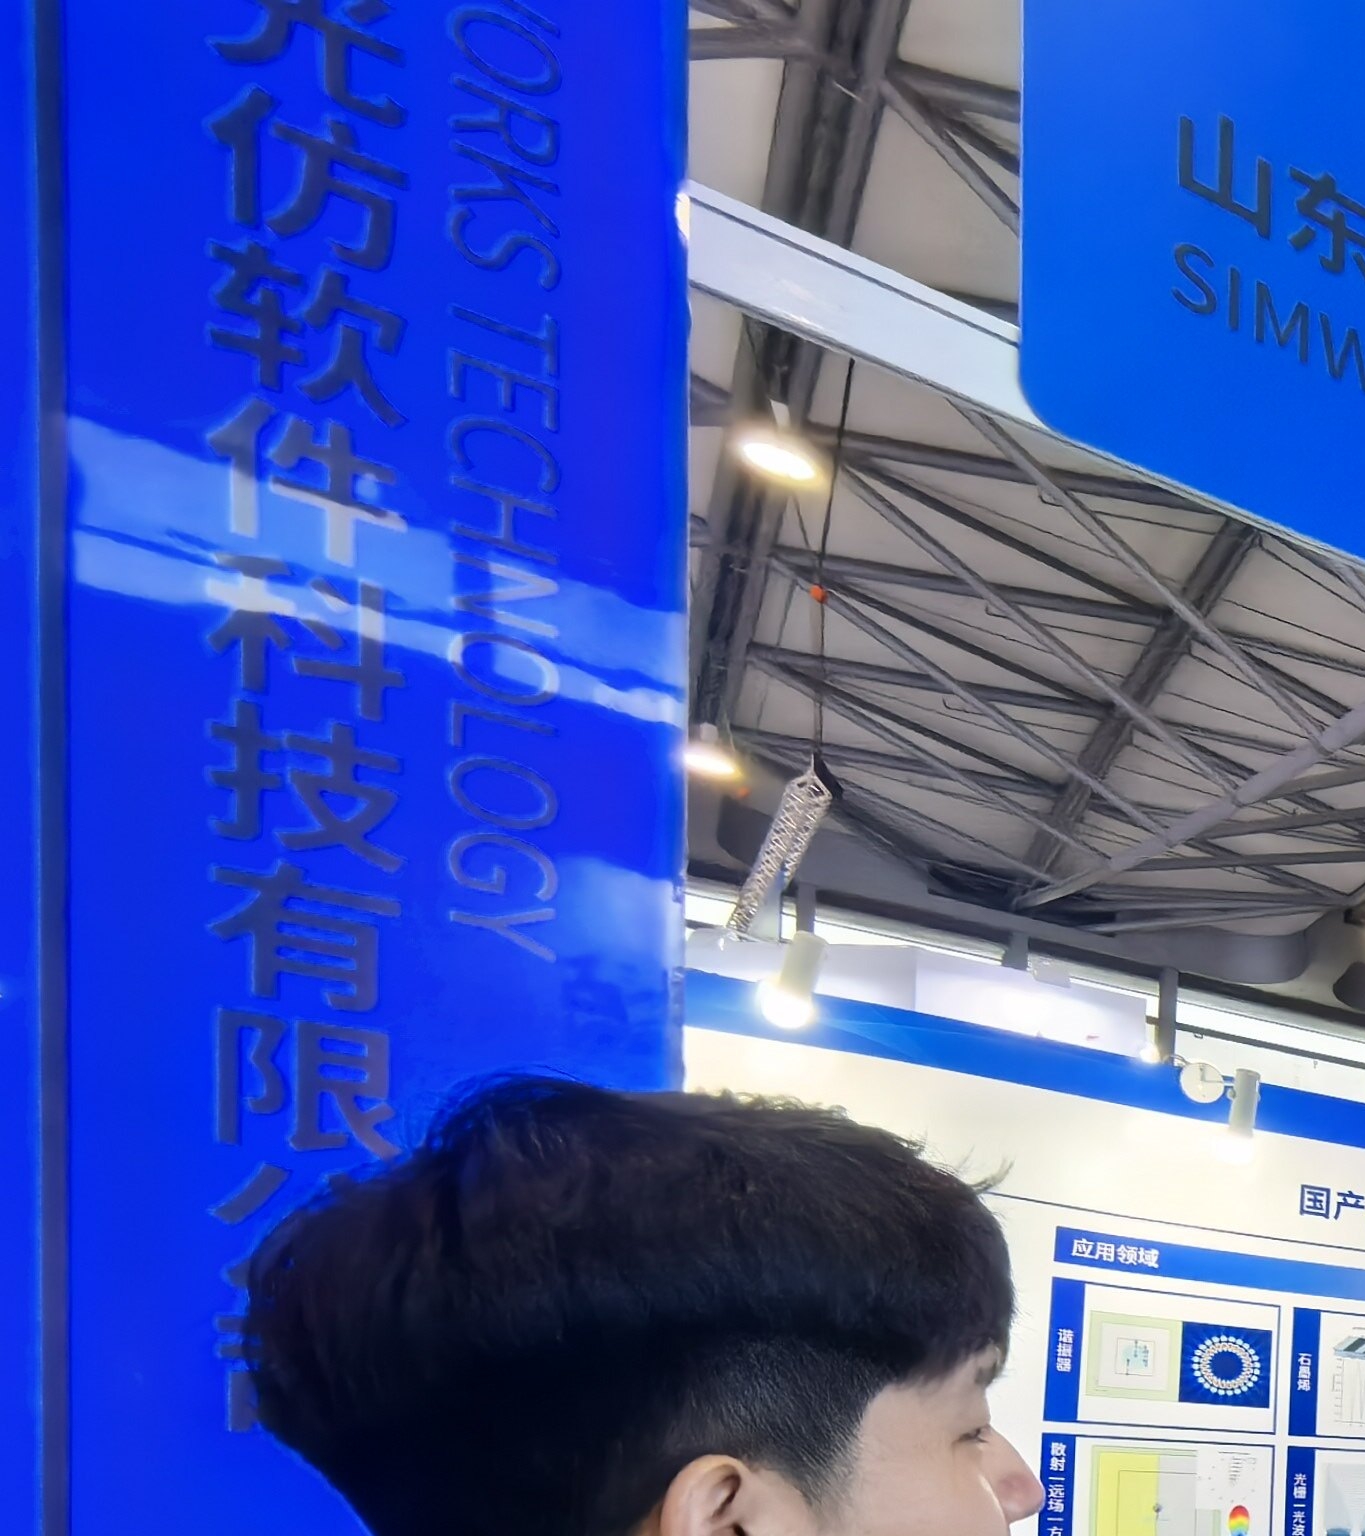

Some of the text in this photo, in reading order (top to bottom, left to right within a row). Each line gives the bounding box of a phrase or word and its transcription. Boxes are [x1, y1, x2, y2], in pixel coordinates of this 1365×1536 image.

[206, 0, 407, 1432] 光仿软件科技有限
[446, 0, 563, 963] ORKS TECHNOLOGY
[1071, 1238, 1160, 1269] 应用领域
